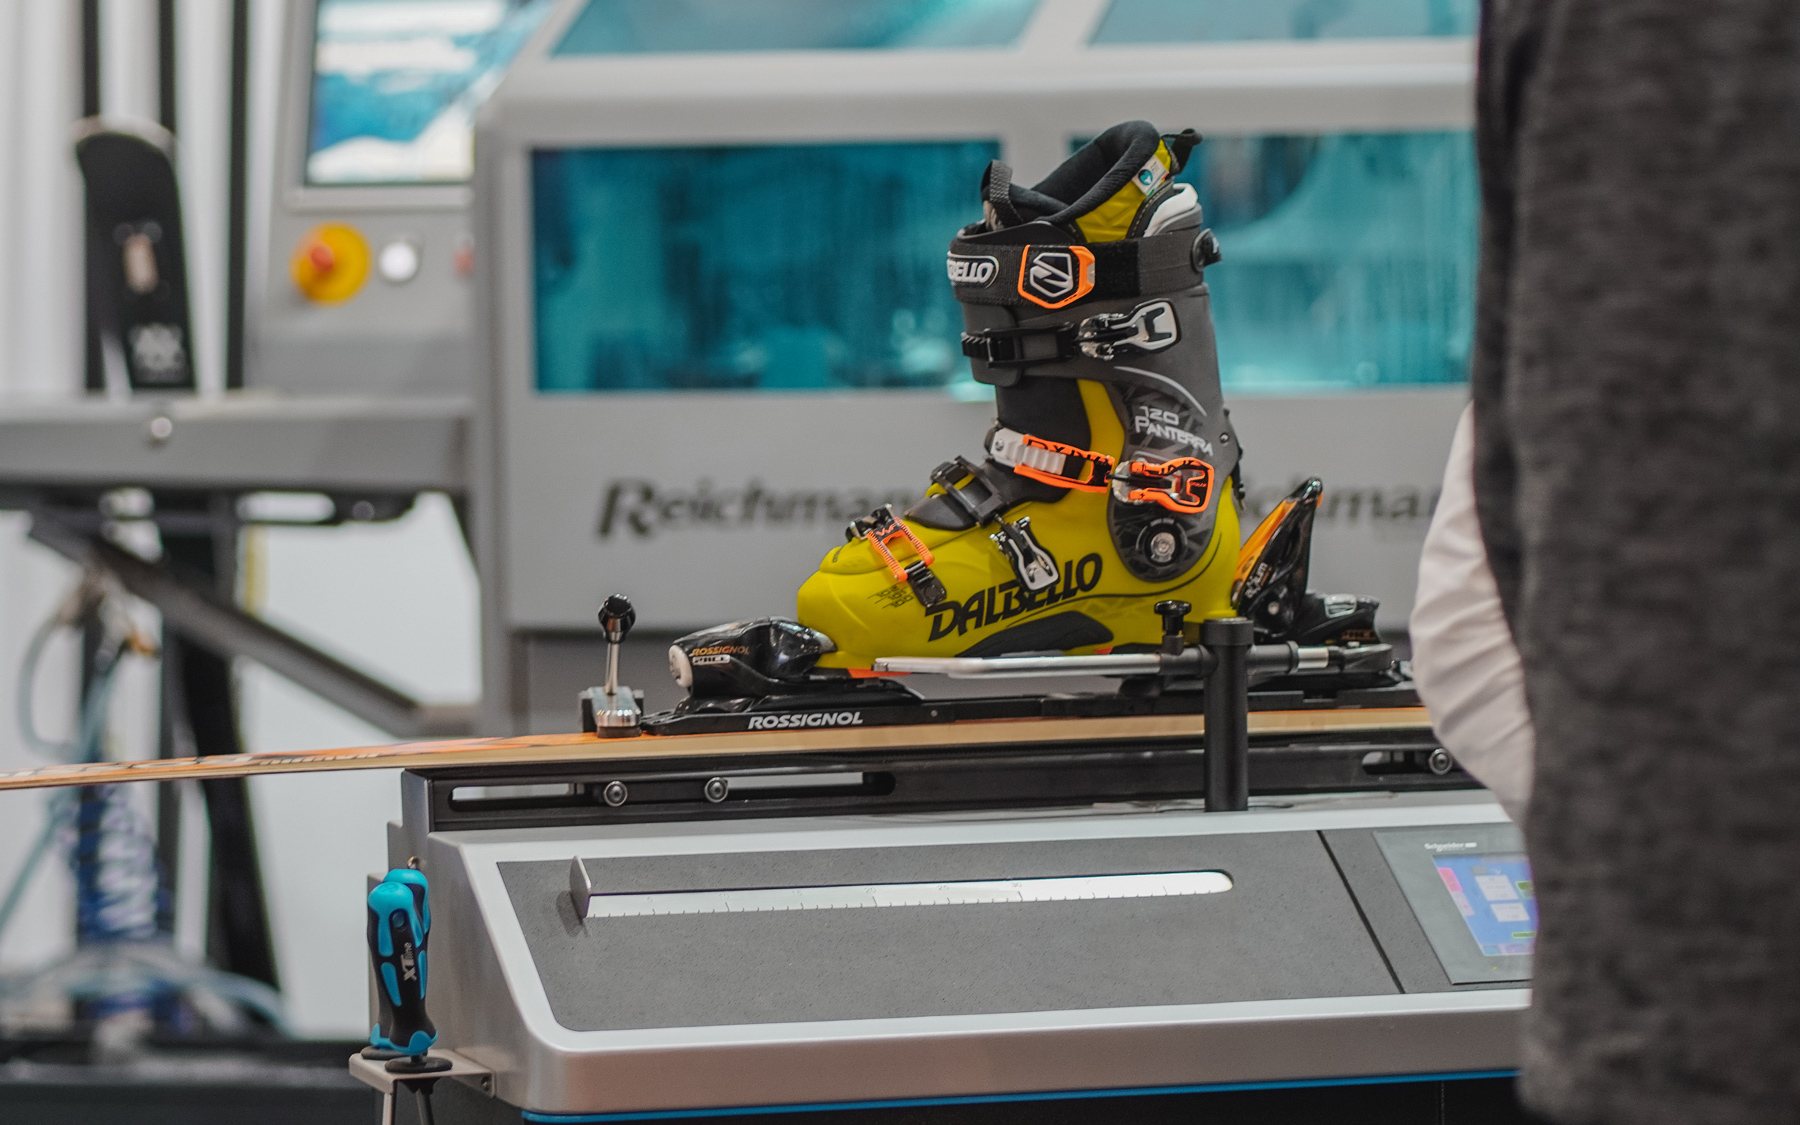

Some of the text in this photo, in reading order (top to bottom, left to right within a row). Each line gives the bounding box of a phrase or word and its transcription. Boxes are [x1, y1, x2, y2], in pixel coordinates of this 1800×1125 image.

[1139, 405, 1180, 426] 120
[924, 552, 1103, 642] DALBELLO
[688, 645, 753, 657] ROSSIGNOL
[747, 711, 864, 730] ROSSIGNOL
